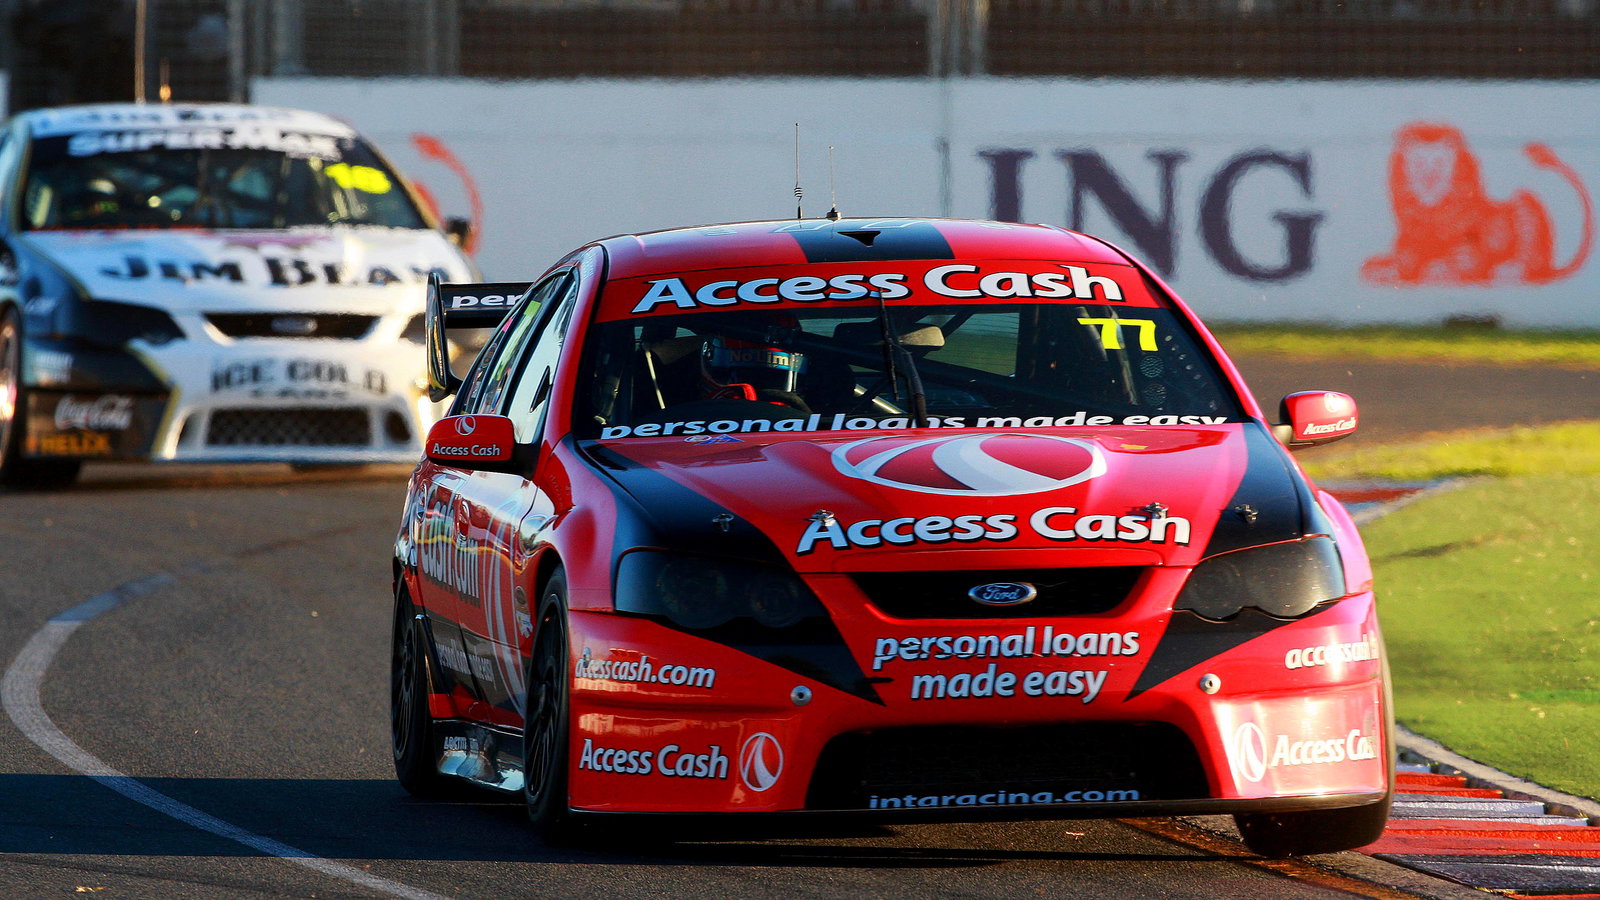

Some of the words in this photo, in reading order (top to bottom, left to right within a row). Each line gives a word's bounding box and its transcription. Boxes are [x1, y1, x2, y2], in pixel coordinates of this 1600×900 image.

[978, 148, 1325, 283] ING
[631, 273, 911, 314] Access
[923, 264, 1125, 302] Cash
[1077, 318, 1159, 352] 77
[601, 413, 821, 440] personal
[976, 411, 1114, 428] made
[1303, 424, 1336, 435] Access
[432, 443, 471, 457] Access
[471, 444, 501, 456] Cash
[796, 513, 1019, 555] Access
[1030, 506, 1193, 546] Cash
[978, 583, 1023, 602] Ford
[872, 625, 1036, 670] personal
[1041, 625, 1141, 656] loans
[574, 655, 717, 689] accesscash.com
[911, 663, 1017, 699] made
[1023, 669, 1109, 704] easy
[578, 738, 652, 775] Access
[657, 744, 730, 779] Cash
[1269, 734, 1346, 767] Access
[868, 789, 1140, 809] intaracing.com
